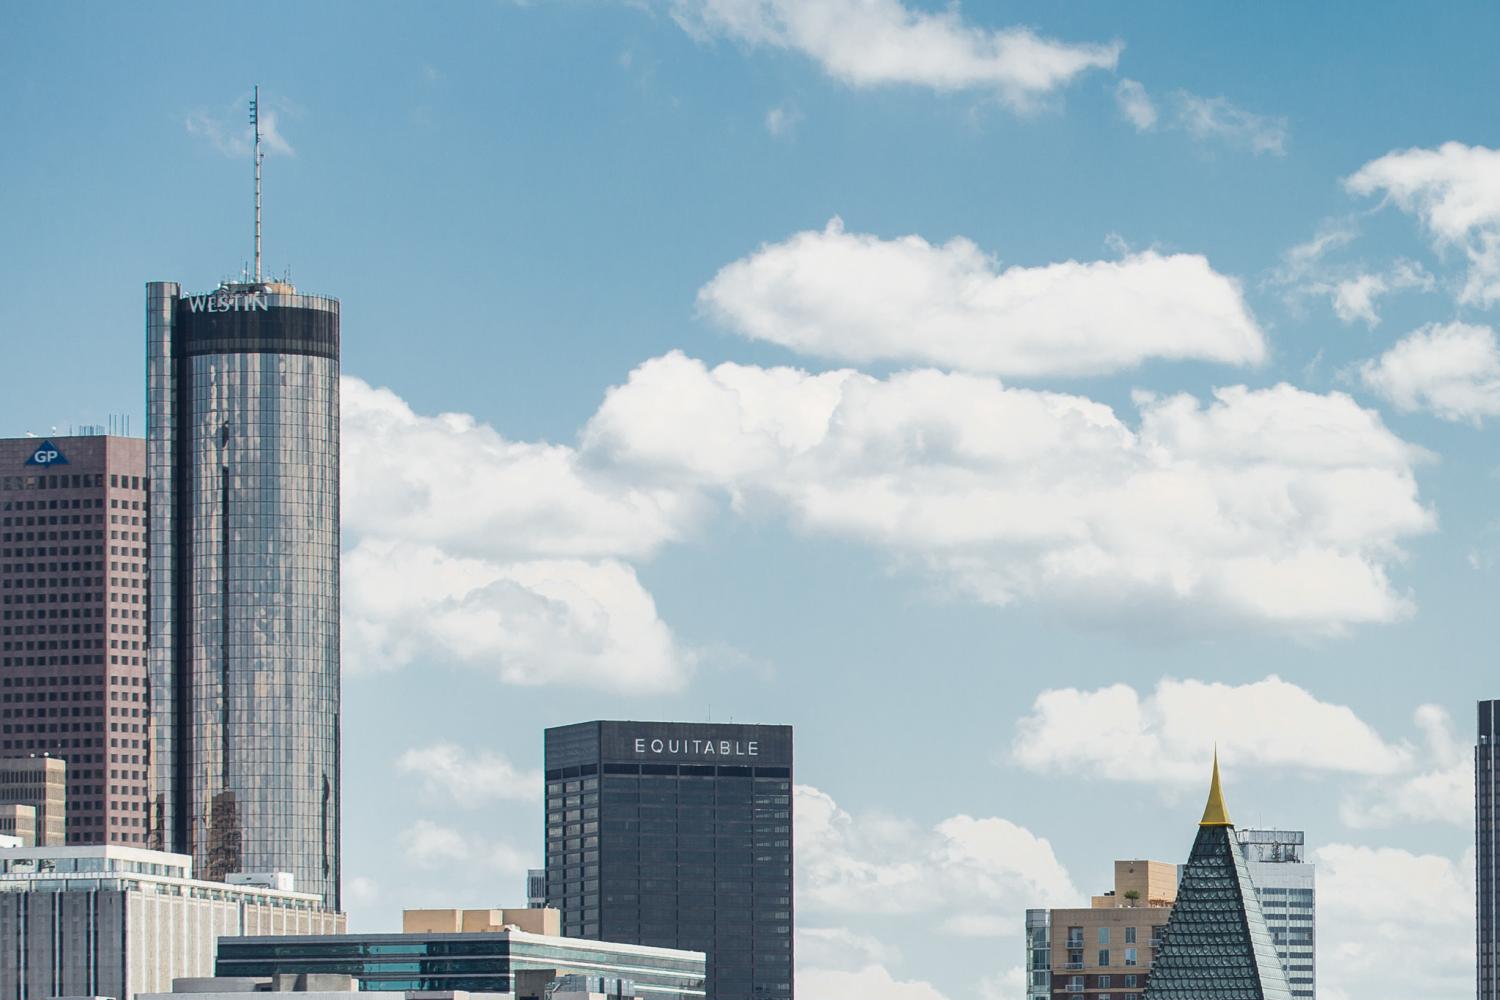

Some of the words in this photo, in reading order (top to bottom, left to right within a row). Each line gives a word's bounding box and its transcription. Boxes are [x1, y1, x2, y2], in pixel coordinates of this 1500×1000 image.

[188, 294, 269, 312] WESTIN
[34, 450, 58, 463] GP
[635, 738, 758, 756] EQUITABLE
